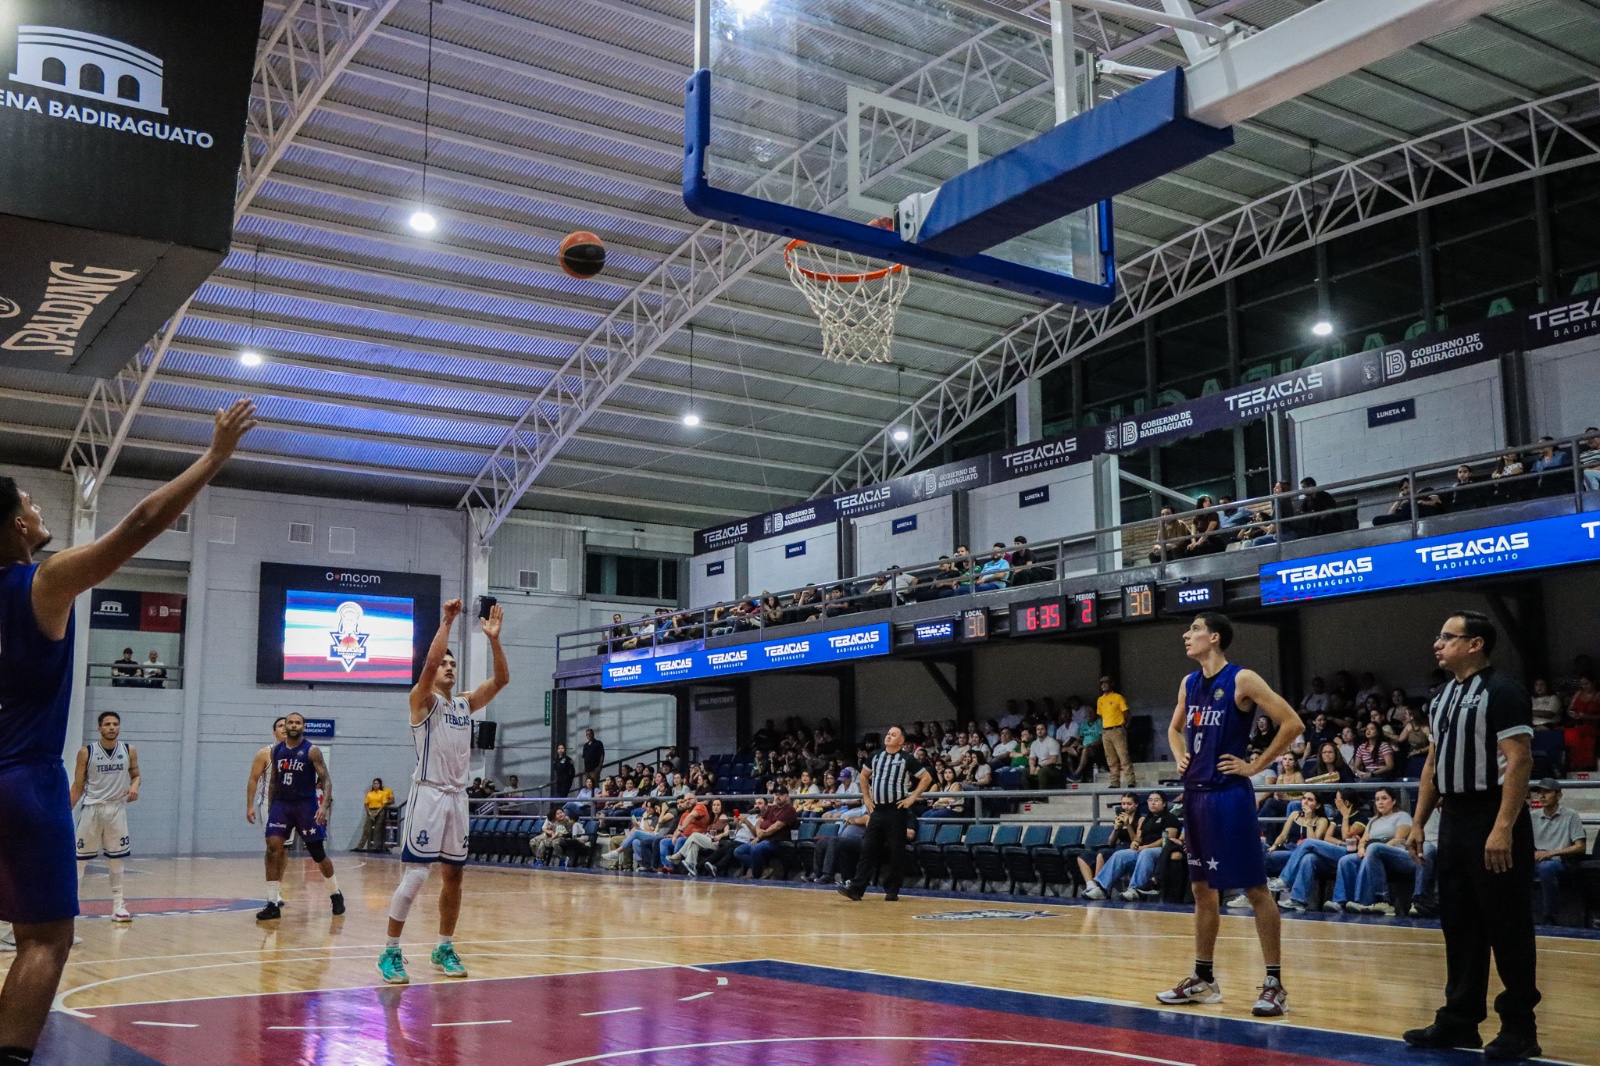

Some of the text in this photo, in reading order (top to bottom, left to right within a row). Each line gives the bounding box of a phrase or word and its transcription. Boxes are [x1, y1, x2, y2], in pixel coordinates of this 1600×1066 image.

[49, 100, 214, 149] BADIRAGUATO
[1, 261, 138, 356] SPALDING
[1409, 341, 1484, 369] BADIRAGUATO
[1411, 333, 1480, 359] GOBIERNO DE
[1224, 371, 1323, 411] TEBACAS
[1240, 392, 1315, 418] BADIRAGUATO
[1376, 408, 1400, 419] LUNETA
[1139, 418, 1193, 438] BADIRAGUATO
[1141, 415, 1179, 430] GOBIERNO
[1179, 411, 1191, 421] DE
[1002, 437, 1077, 468] TEBACAS
[1014, 455, 1070, 474] BADIRAGUATO
[833, 486, 891, 510] TEBACAS
[842, 501, 886, 516] BADIRAGUATO
[702, 522, 748, 544] TEBACAS
[1415, 532, 1530, 564] TEBACAS
[1277, 556, 1373, 584] TEBACAS
[1435, 552, 1519, 571] BADIRAGUATO
[1125, 584, 1149, 594] VISITA
[1293, 575, 1364, 591] BADIRAGUATO
[1075, 592, 1095, 602] PERIODO
[1130, 591, 1152, 617] 30
[964, 609, 983, 618] LOCAL
[1026, 603, 1061, 631] 6:35
[1081, 599, 1093, 624] 2
[964, 614, 986, 638] 30
[828, 630, 880, 648] TEBACAS
[707, 650, 748, 665] TEBACAS
[764, 641, 810, 657] TEBACAS
[608, 665, 643, 678] TEBACAS
[655, 658, 693, 672] TEBACAS
[96, 763, 124, 773] TEBACAS
[283, 772, 293, 786] 15
[119, 836, 130, 847] 33
